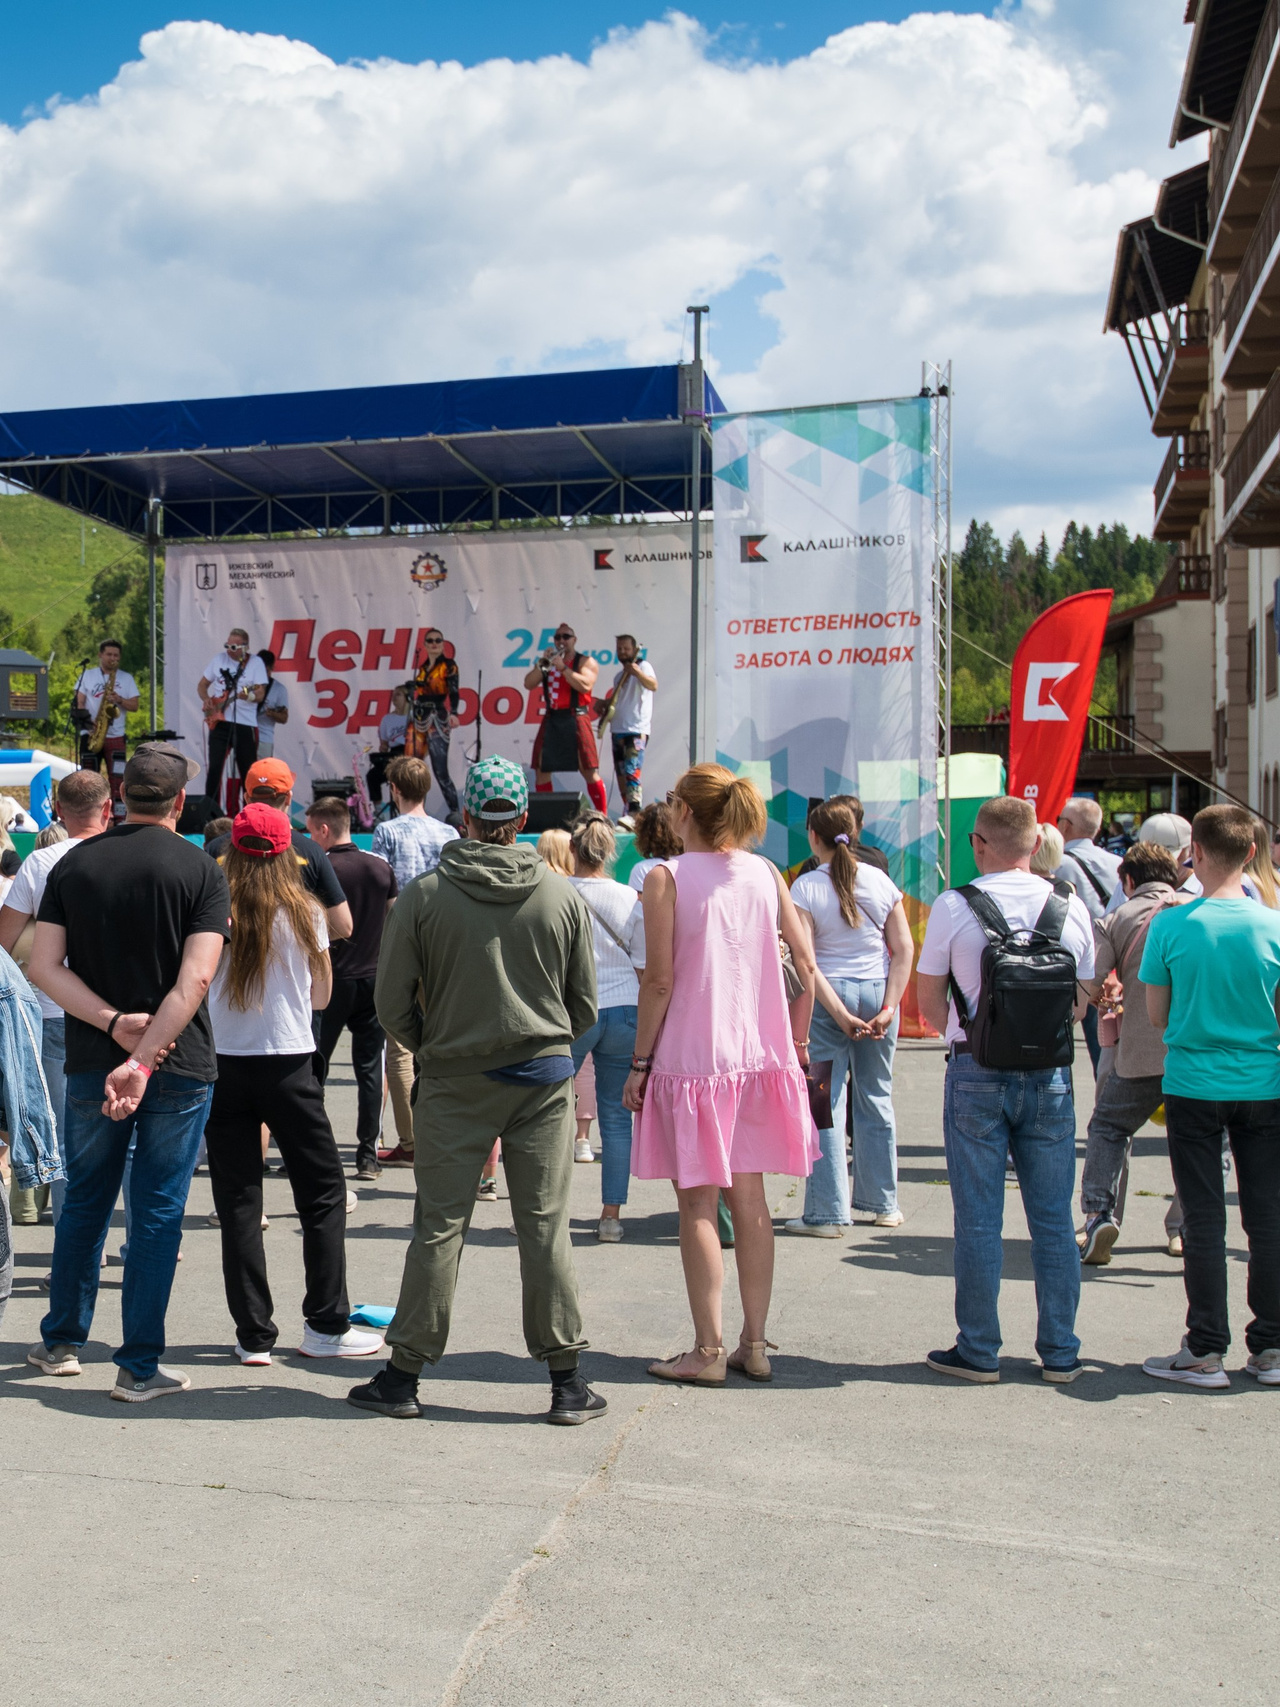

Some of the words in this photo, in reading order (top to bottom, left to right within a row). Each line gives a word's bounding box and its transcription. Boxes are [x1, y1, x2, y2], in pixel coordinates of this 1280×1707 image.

[783, 533, 907, 554] КАЛАШНИКОВ
[228, 560, 274, 570] ИЖЕВСКИЙ
[229, 569, 295, 580] МЕХАНИЧЕСКИЙ
[229, 582, 257, 590] ЗАВОД
[727, 610, 922, 637] ОТВЕТСТВЕННОСТЬ
[268, 619, 456, 682] День
[734, 648, 812, 669] ЗАБОТА
[818, 649, 834, 667] О
[837, 645, 915, 667] ЛЮДЯХ
